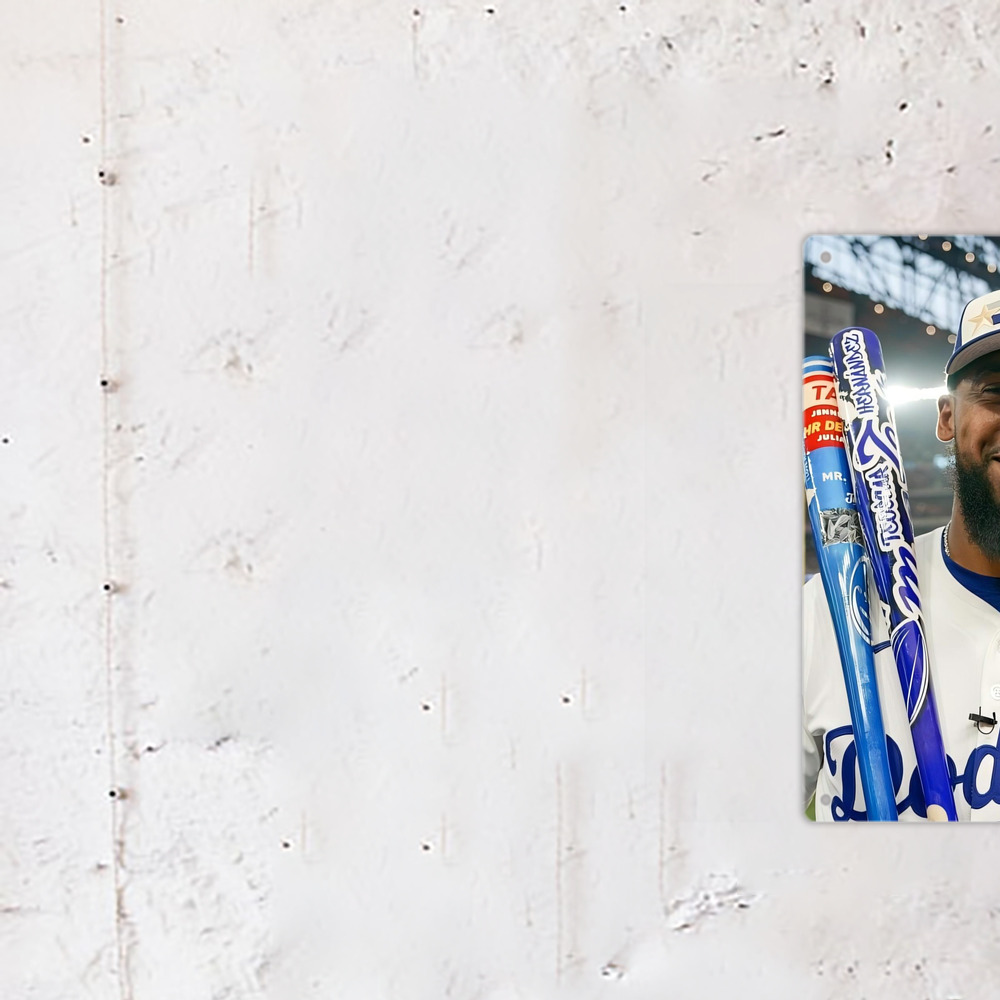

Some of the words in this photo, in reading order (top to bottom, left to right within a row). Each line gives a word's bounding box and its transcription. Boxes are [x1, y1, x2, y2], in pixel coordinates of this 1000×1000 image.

[811, 385, 837, 400] TA
[803, 421, 821, 439] HR
[824, 420, 843, 432] DE
